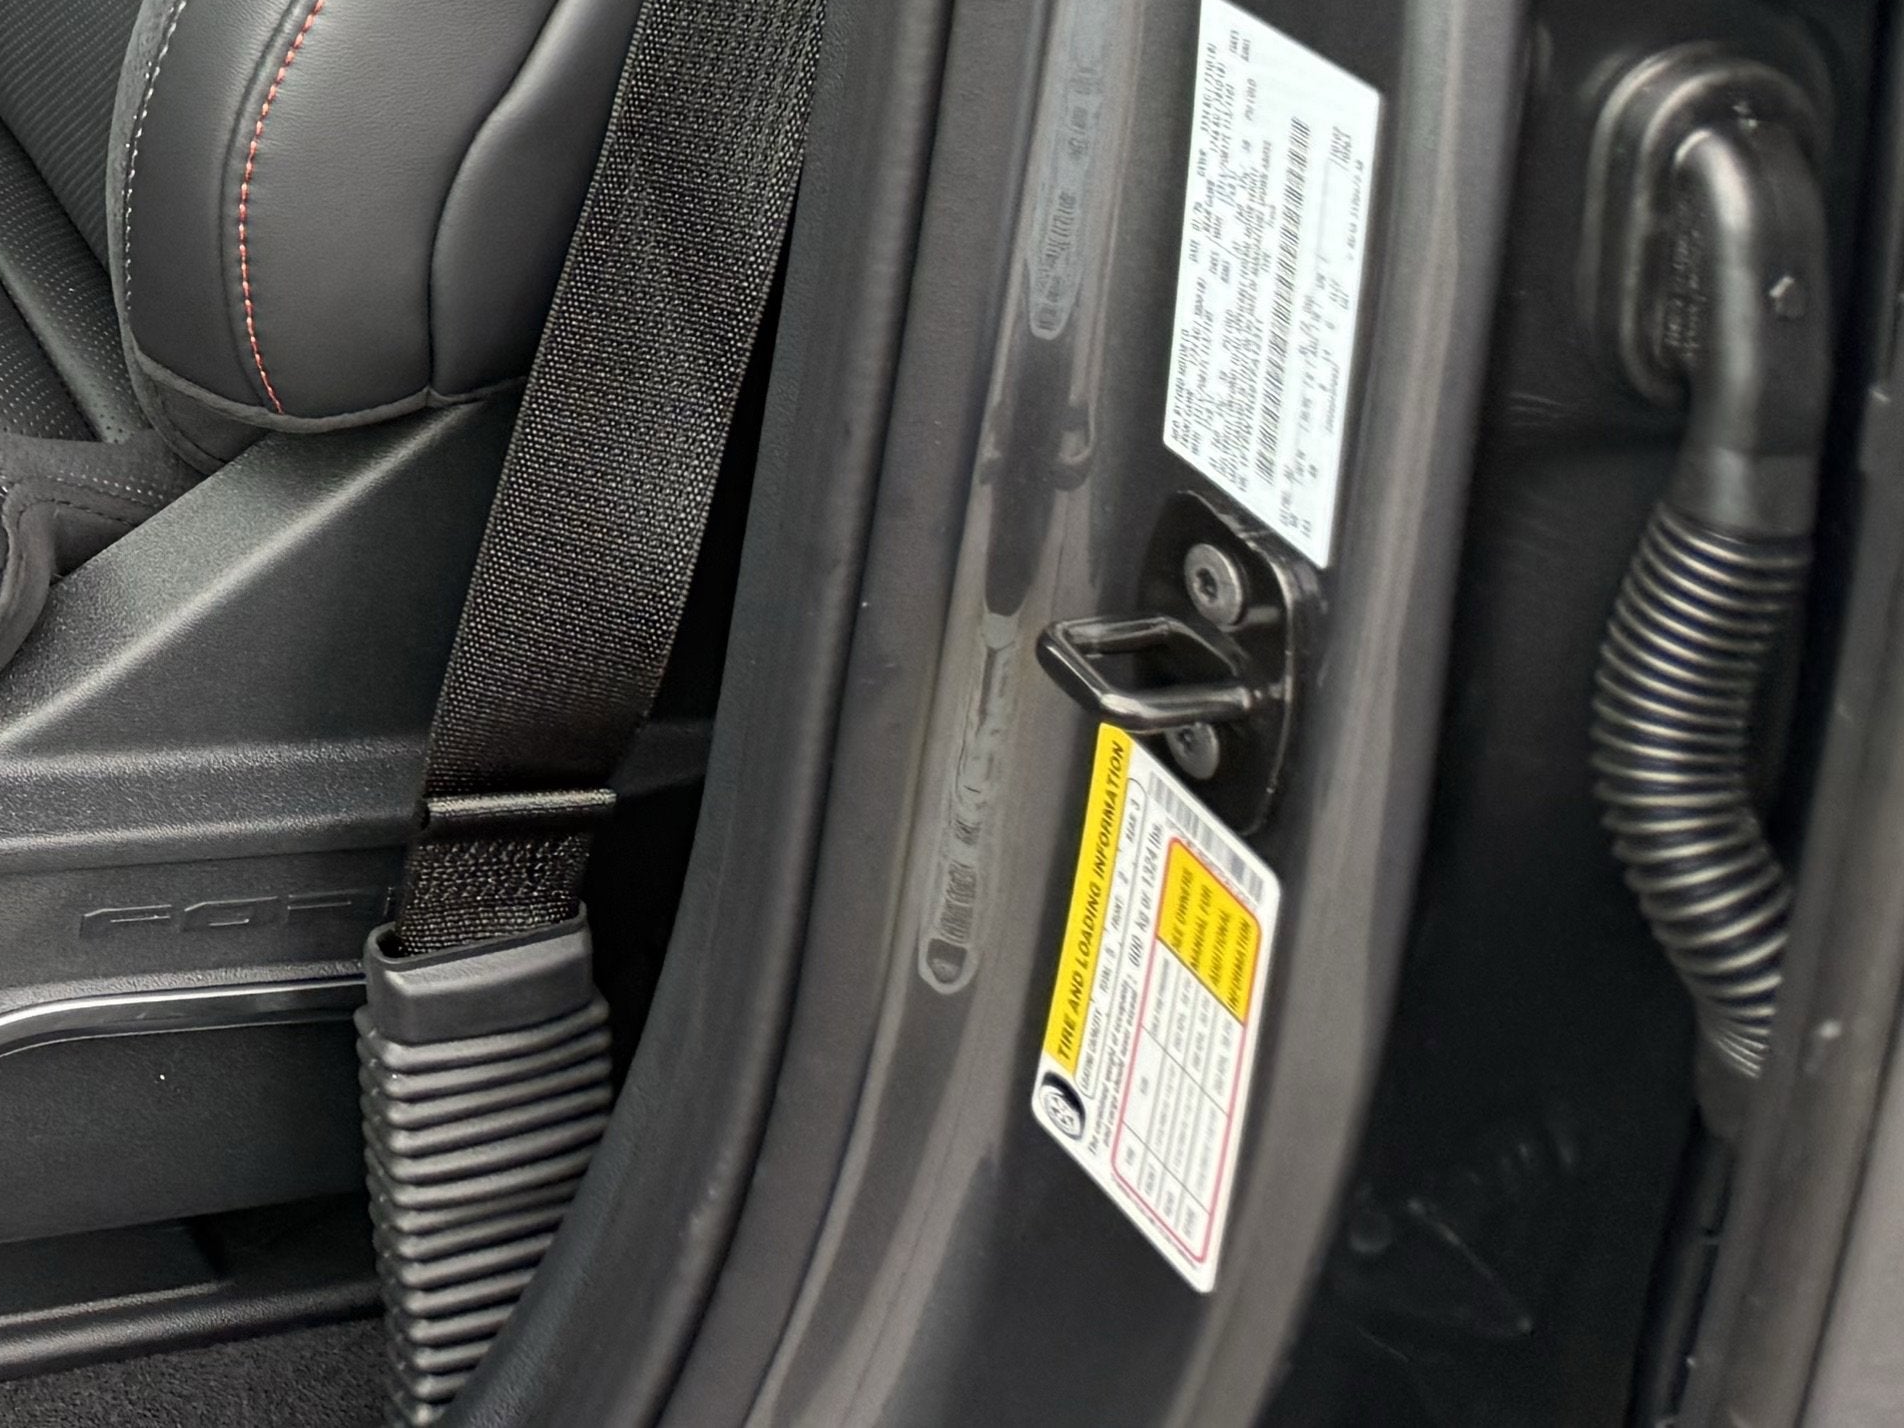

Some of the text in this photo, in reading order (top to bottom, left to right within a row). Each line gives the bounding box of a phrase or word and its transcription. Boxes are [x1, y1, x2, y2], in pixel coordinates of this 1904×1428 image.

[1140, 844, 1159, 890] 1324
[1056, 738, 1127, 1066] TIRE AND LOADING INFORMATION
[1139, 888, 1152, 912] or
[1133, 906, 1150, 935] kg
